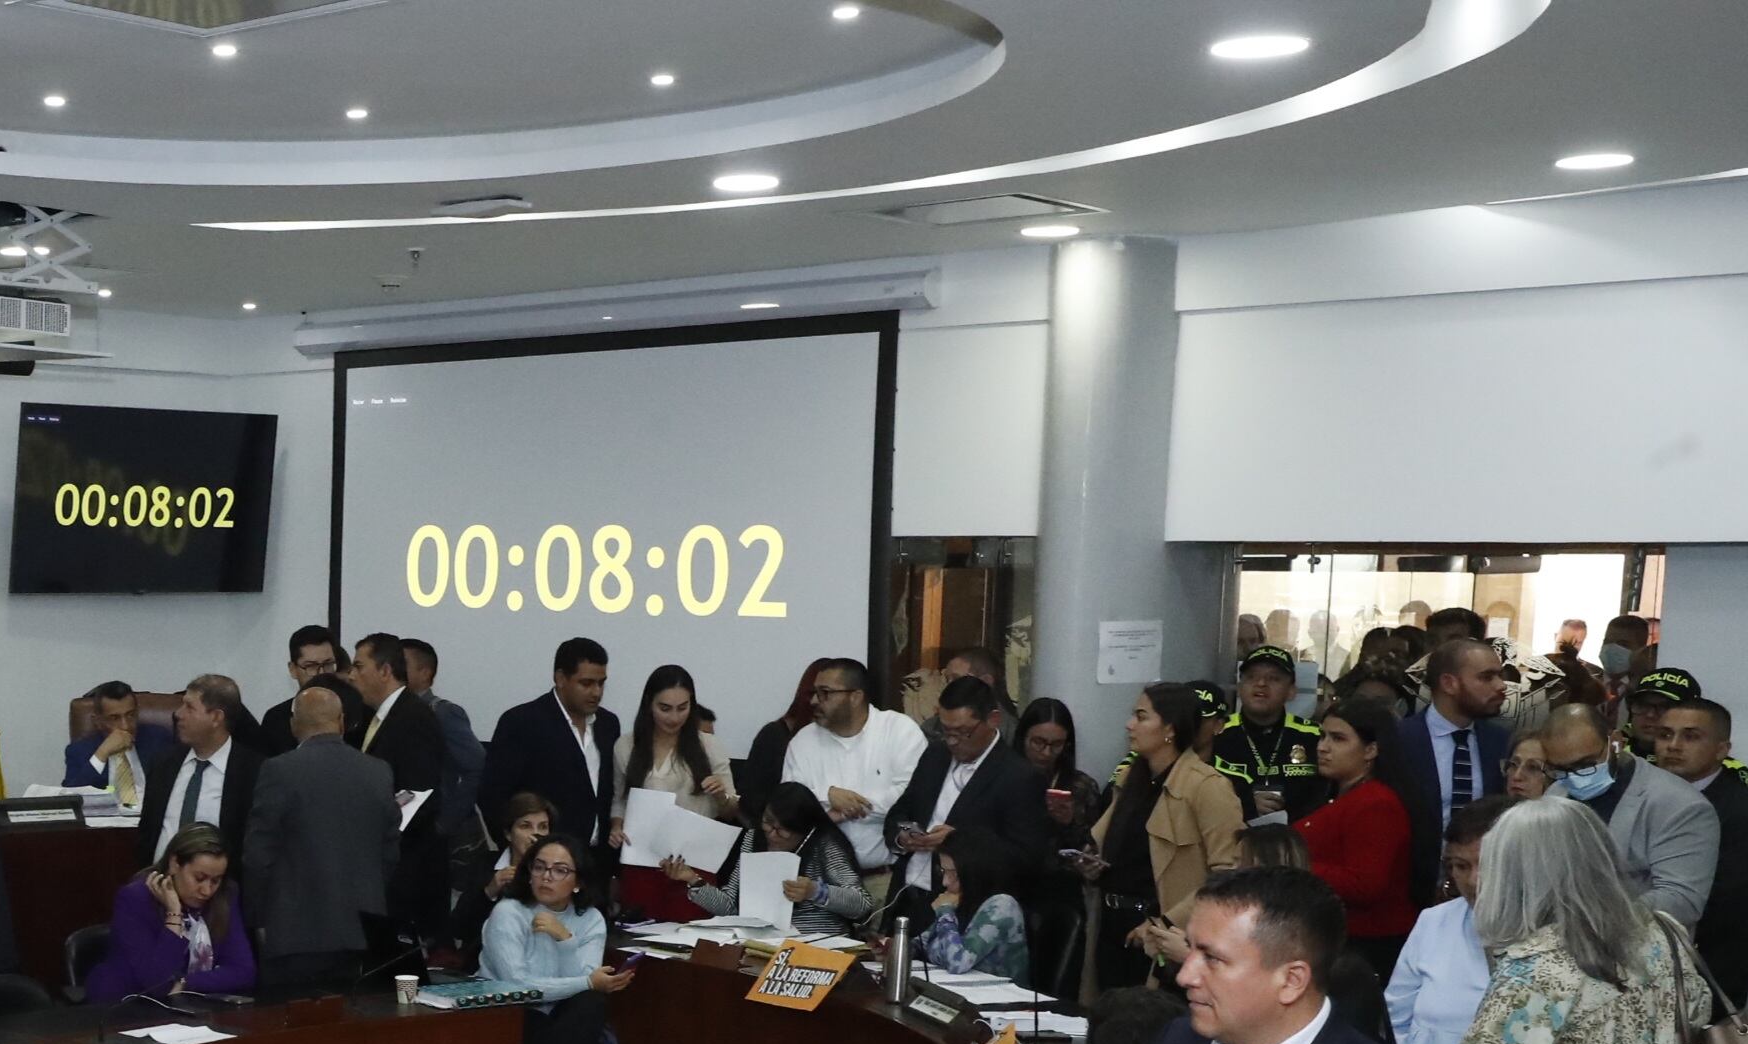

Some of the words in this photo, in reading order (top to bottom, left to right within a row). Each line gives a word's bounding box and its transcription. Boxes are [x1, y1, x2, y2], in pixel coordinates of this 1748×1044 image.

[55, 483, 235, 529] 00:08:02
[406, 523, 787, 618] 00:08:02
[1639, 672, 1689, 689] POLICÍA
[789, 968, 835, 986] REFORMA
[768, 981, 782, 995] LA
